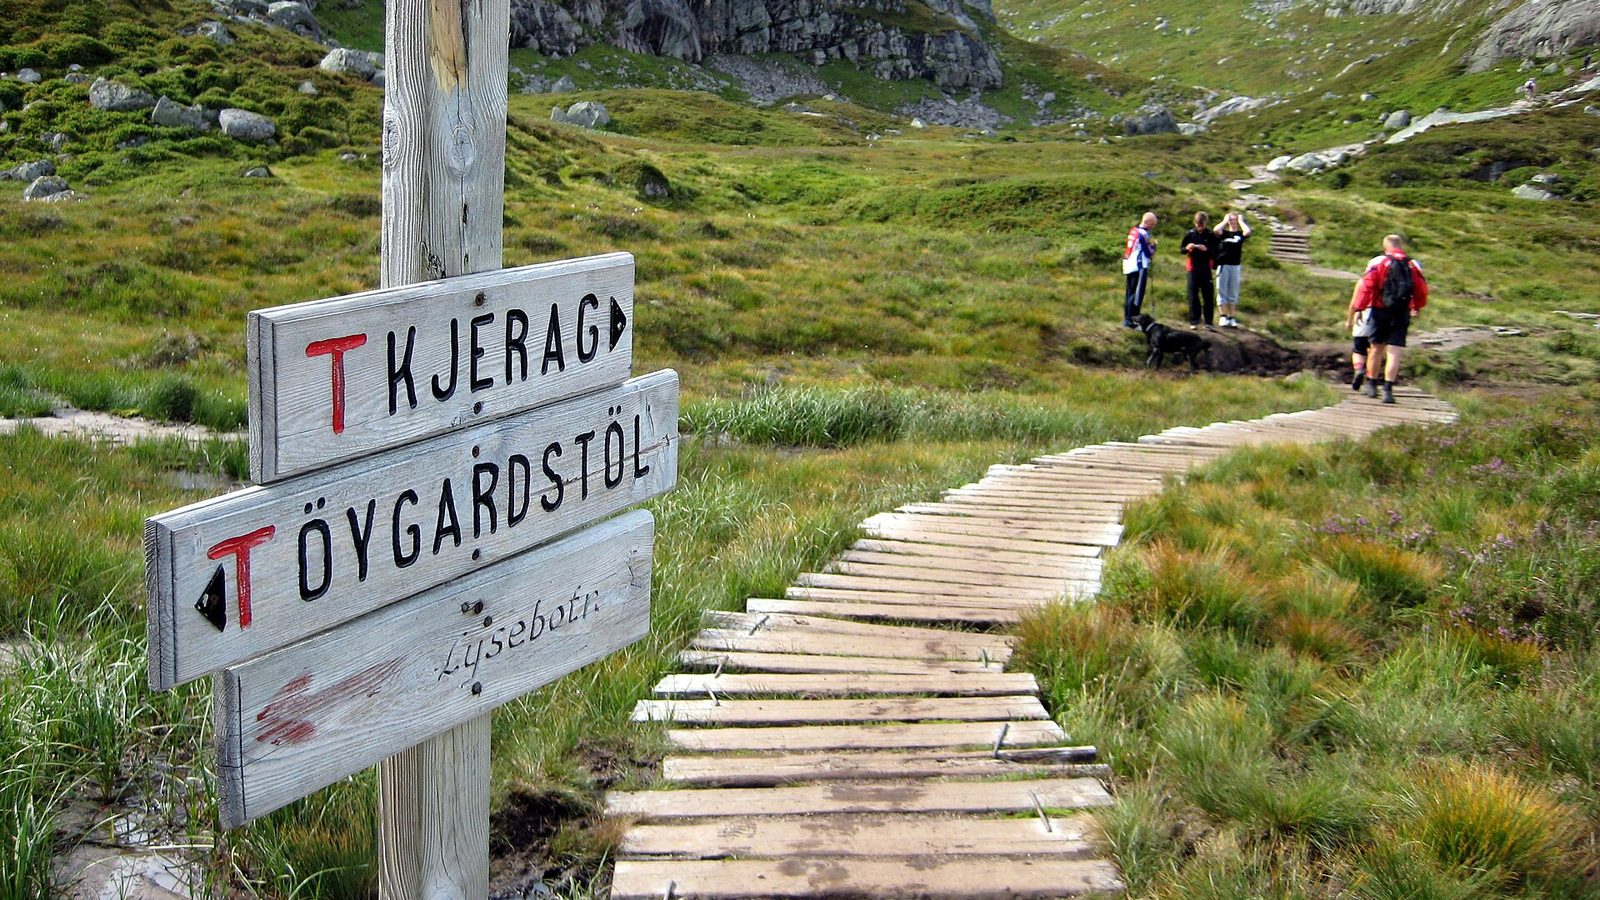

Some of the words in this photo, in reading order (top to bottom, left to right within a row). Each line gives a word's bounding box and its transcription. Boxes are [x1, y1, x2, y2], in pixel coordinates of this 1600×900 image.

[305, 333, 368, 434] T
[387, 293, 599, 416] KJERAG
[298, 405, 650, 602] ÖYGARDSTÖL
